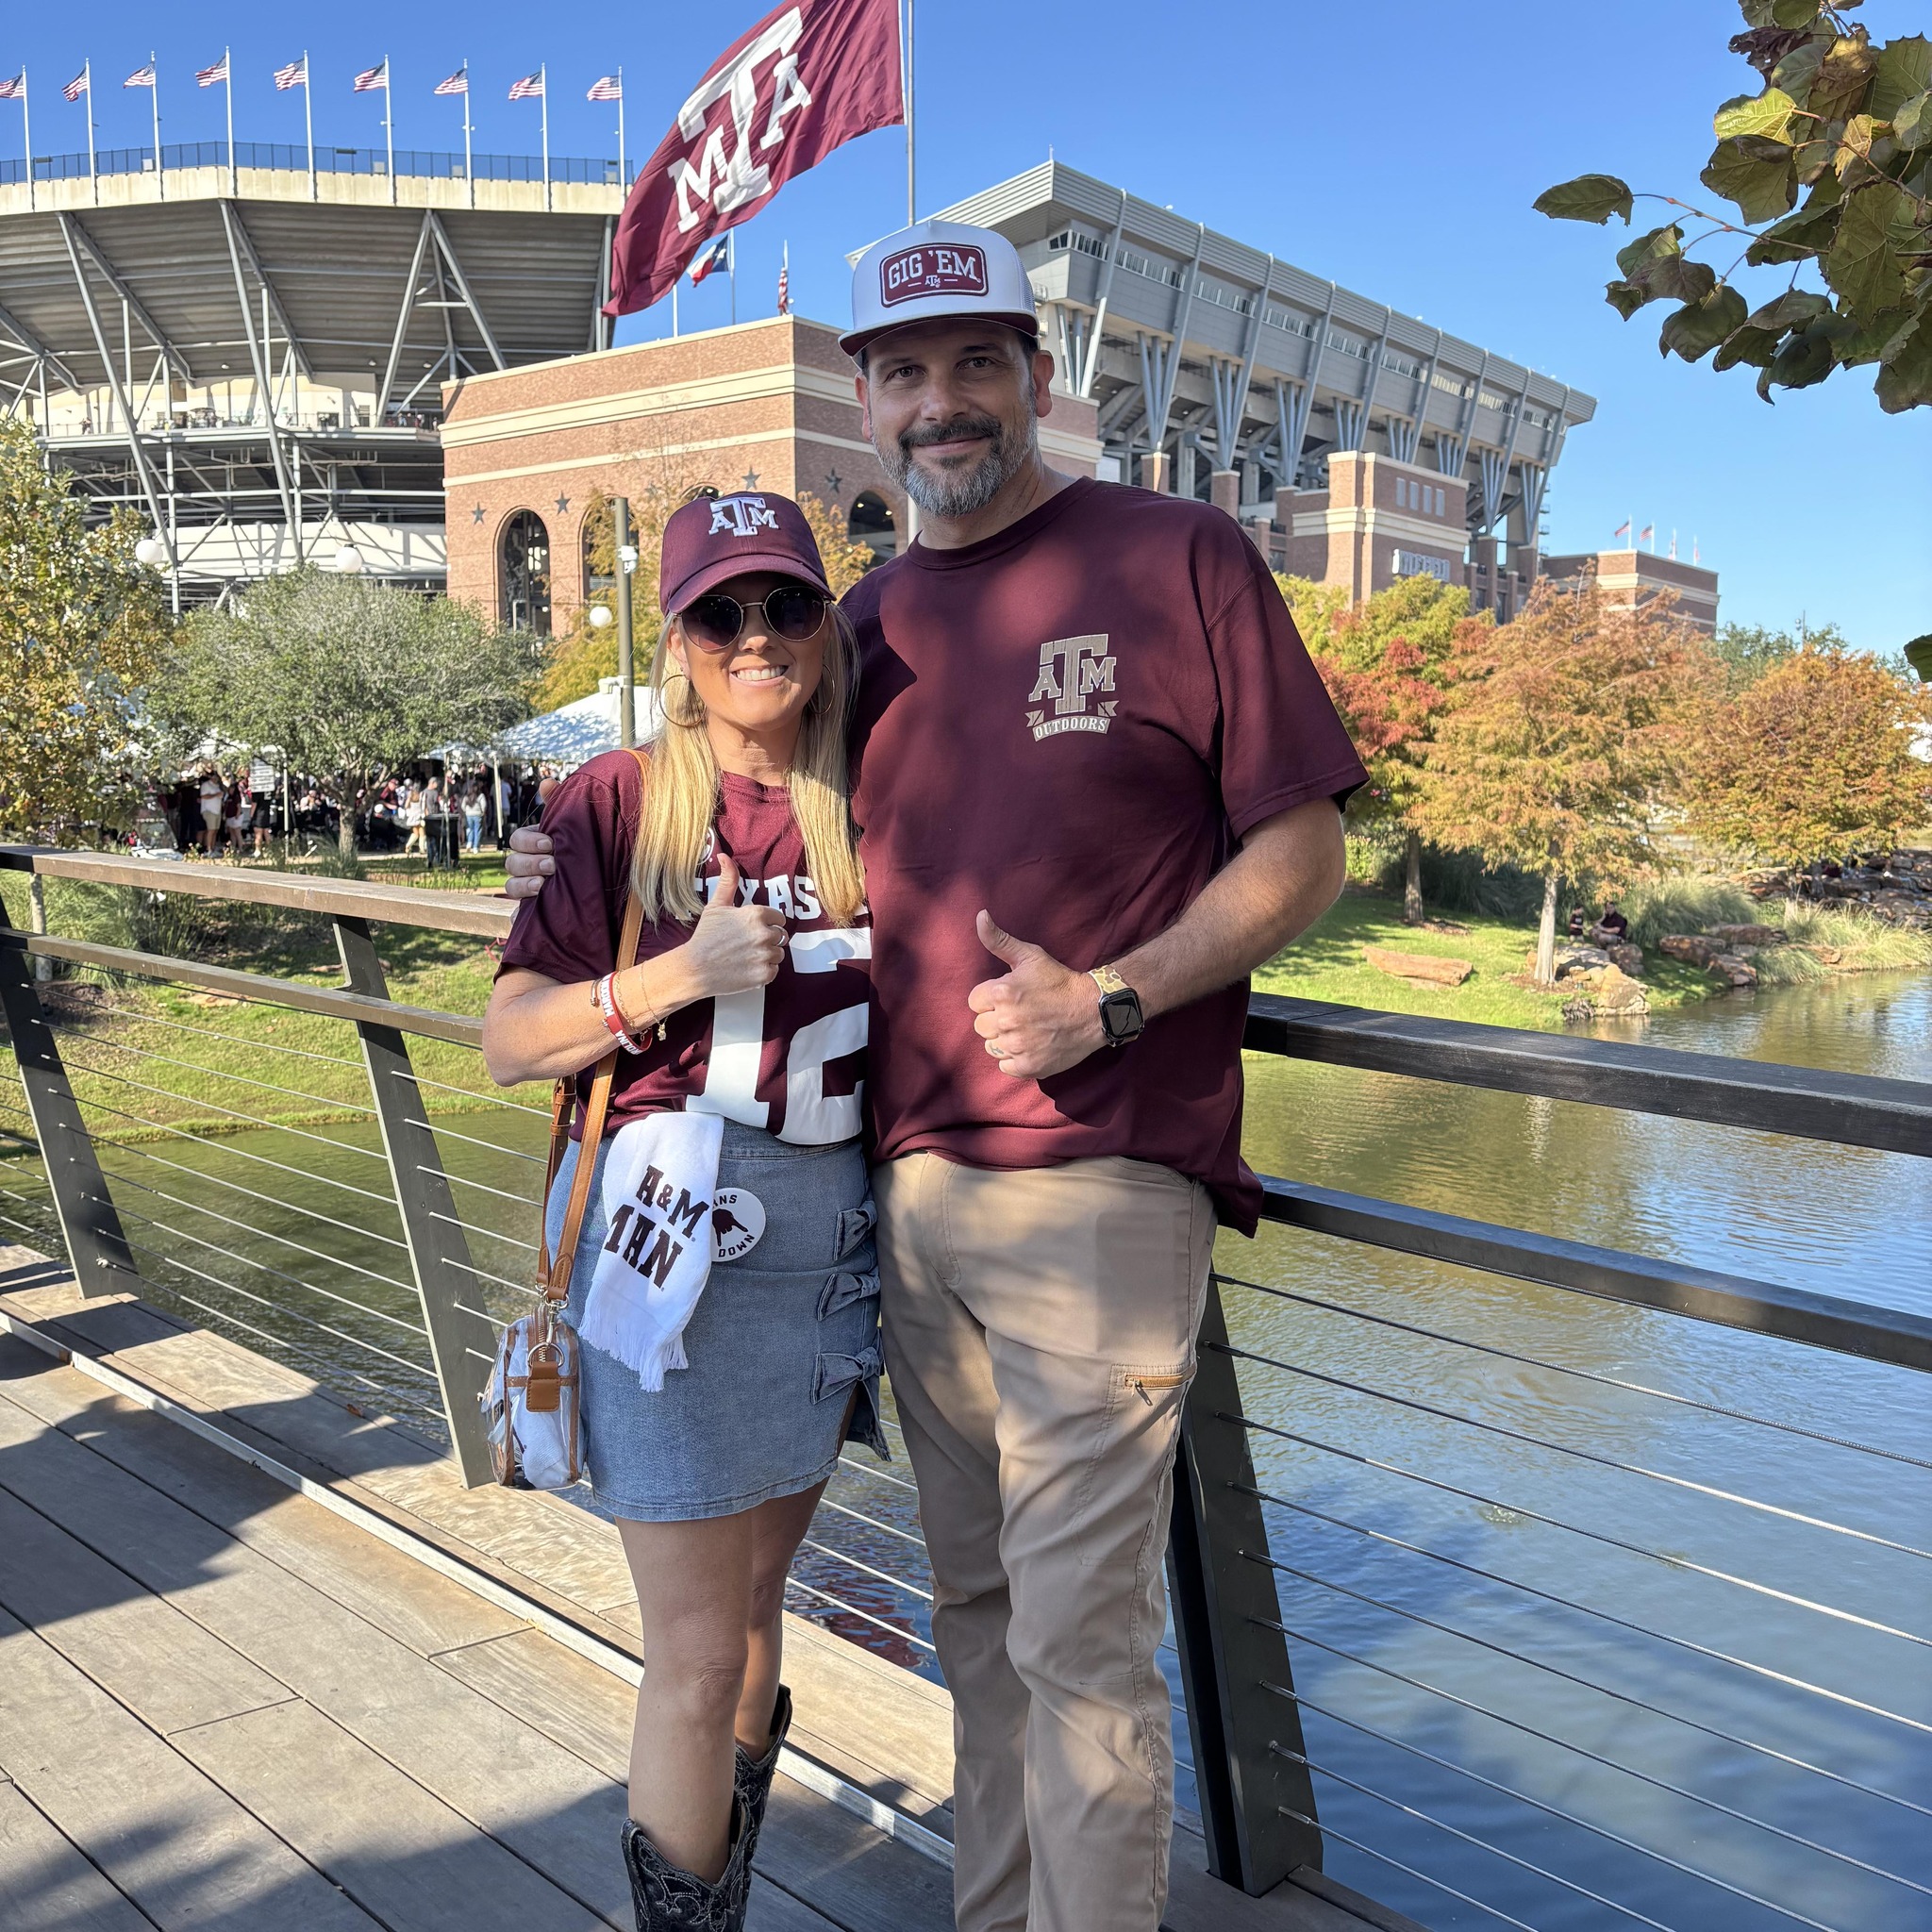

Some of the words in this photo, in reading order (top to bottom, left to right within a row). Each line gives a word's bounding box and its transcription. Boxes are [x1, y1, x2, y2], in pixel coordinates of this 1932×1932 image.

[888, 253, 923, 290] GIG
[928, 250, 979, 280] 'EM
[1035, 717, 1108, 739] OUTDOORS
[636, 1164, 710, 1240] A&M
[718, 1234, 756, 1258] DOWN
